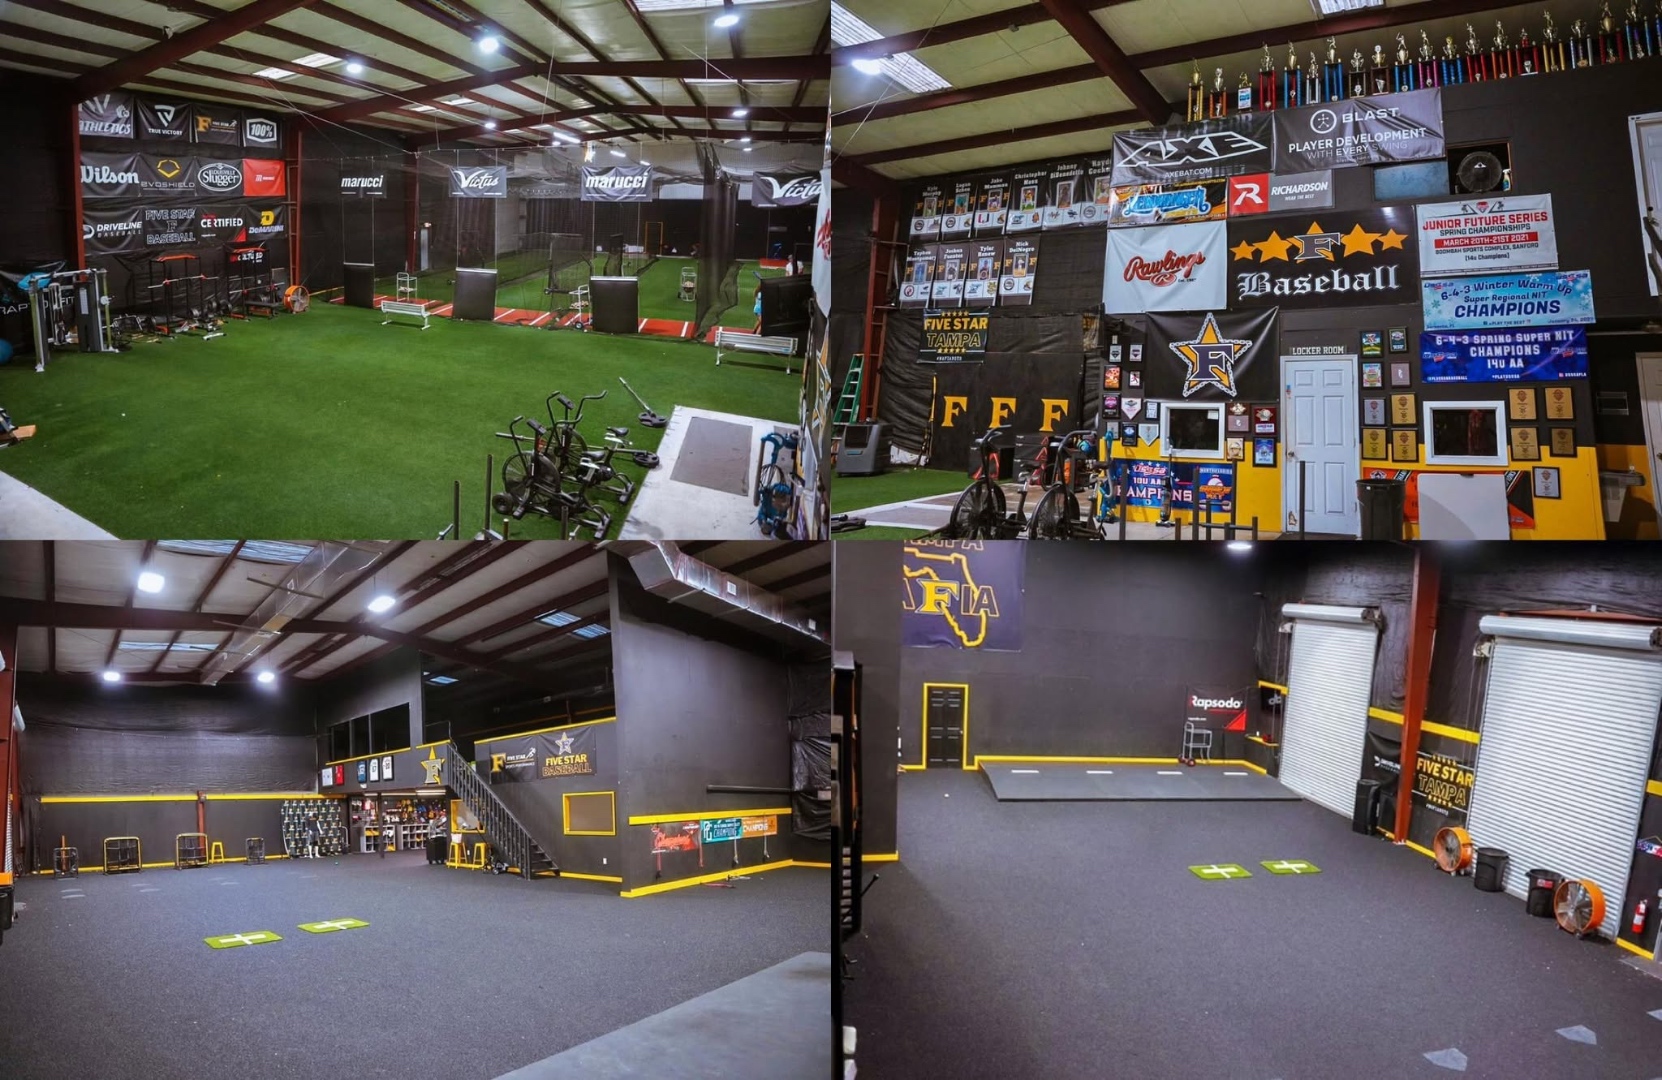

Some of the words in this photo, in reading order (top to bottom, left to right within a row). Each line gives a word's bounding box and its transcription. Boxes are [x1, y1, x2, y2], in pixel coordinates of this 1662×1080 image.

[1342, 107, 1399, 123] BLAST
[195, 115, 212, 132] F
[251, 123, 273, 138] 100%
[1288, 139, 1333, 153] PLAYER
[1336, 128, 1426, 146] DEVELOPMENT
[1116, 131, 1268, 168] AXE
[1306, 150, 1333, 160] WITH
[1336, 145, 1369, 156] EVERY
[1372, 141, 1408, 151] SWING
[80, 165, 139, 184] Wilson
[202, 170, 239, 187] Slugger
[454, 170, 500, 189] Victus
[585, 172, 648, 188] marucci
[1164, 167, 1212, 179] AXEBAT.COM
[341, 175, 384, 188] marucci
[760, 176, 822, 200] Victu
[1271, 181, 1328, 196] RICHARDSON
[144, 208, 170, 220] FIVE
[170, 208, 196, 219] STAR
[1422, 218, 1461, 231] JUNIOR
[1464, 215, 1506, 228] FUTURE
[1508, 211, 1548, 224] SERIES
[97, 221, 142, 232] DRIVELINE
[166, 220, 178, 233] F
[201, 218, 243, 228] CERTIFIED
[1440, 228, 1467, 237] SPRING
[1468, 223, 1531, 235] CHAMPIONSHIPS
[146, 232, 196, 245] BASEBALL
[1293, 232, 1341, 260] F
[1443, 238, 1469, 247] MARCH
[1470, 235, 1509, 245] 20TH-21ST
[1511, 233, 1529, 242] 2021
[1512, 242, 1539, 250] SANFORD
[1123, 250, 1206, 282] Rawlings
[1237, 264, 1400, 301] Baseball
[1441, 285, 1471, 301] 6-4-3
[1473, 281, 1514, 292] Winter
[1518, 279, 1554, 290] Warm
[1557, 283, 1572, 296] Up
[1464, 295, 1489, 304] Super
[1492, 292, 1529, 302] Regional
[1531, 291, 1548, 299] NIT
[1454, 300, 1561, 318] CHAMPIONS
[924, 318, 951, 330] FIVE
[953, 317, 988, 330] STAR
[927, 332, 981, 347] TAMPA
[1436, 335, 1469, 345] 6-4-3
[1473, 334, 1512, 344] SPRING
[1516, 332, 1551, 342] SUPER
[1554, 330, 1574, 341] NIT
[1292, 346, 1321, 355] LOCKER
[1323, 345, 1344, 354] ROOM
[1470, 345, 1540, 357] CHAMPIONS
[1187, 343, 1234, 381] F
[1510, 358, 1524, 368] AA
[941, 396, 968, 427] F
[989, 397, 1017, 428] F
[1039, 398, 1069, 432] F
[1133, 477, 1148, 485] 10U
[1117, 485, 1193, 502] AMPINS
[490, 753, 506, 772] F
[545, 757, 563, 767] FIVE
[564, 754, 587, 764] STAR
[424, 759, 443, 784] F
[542, 763, 592, 776] BASEBALL
[1416, 757, 1441, 777] FIVE
[1441, 766, 1474, 787] STAR
[1418, 774, 1466, 806] TAMPA
